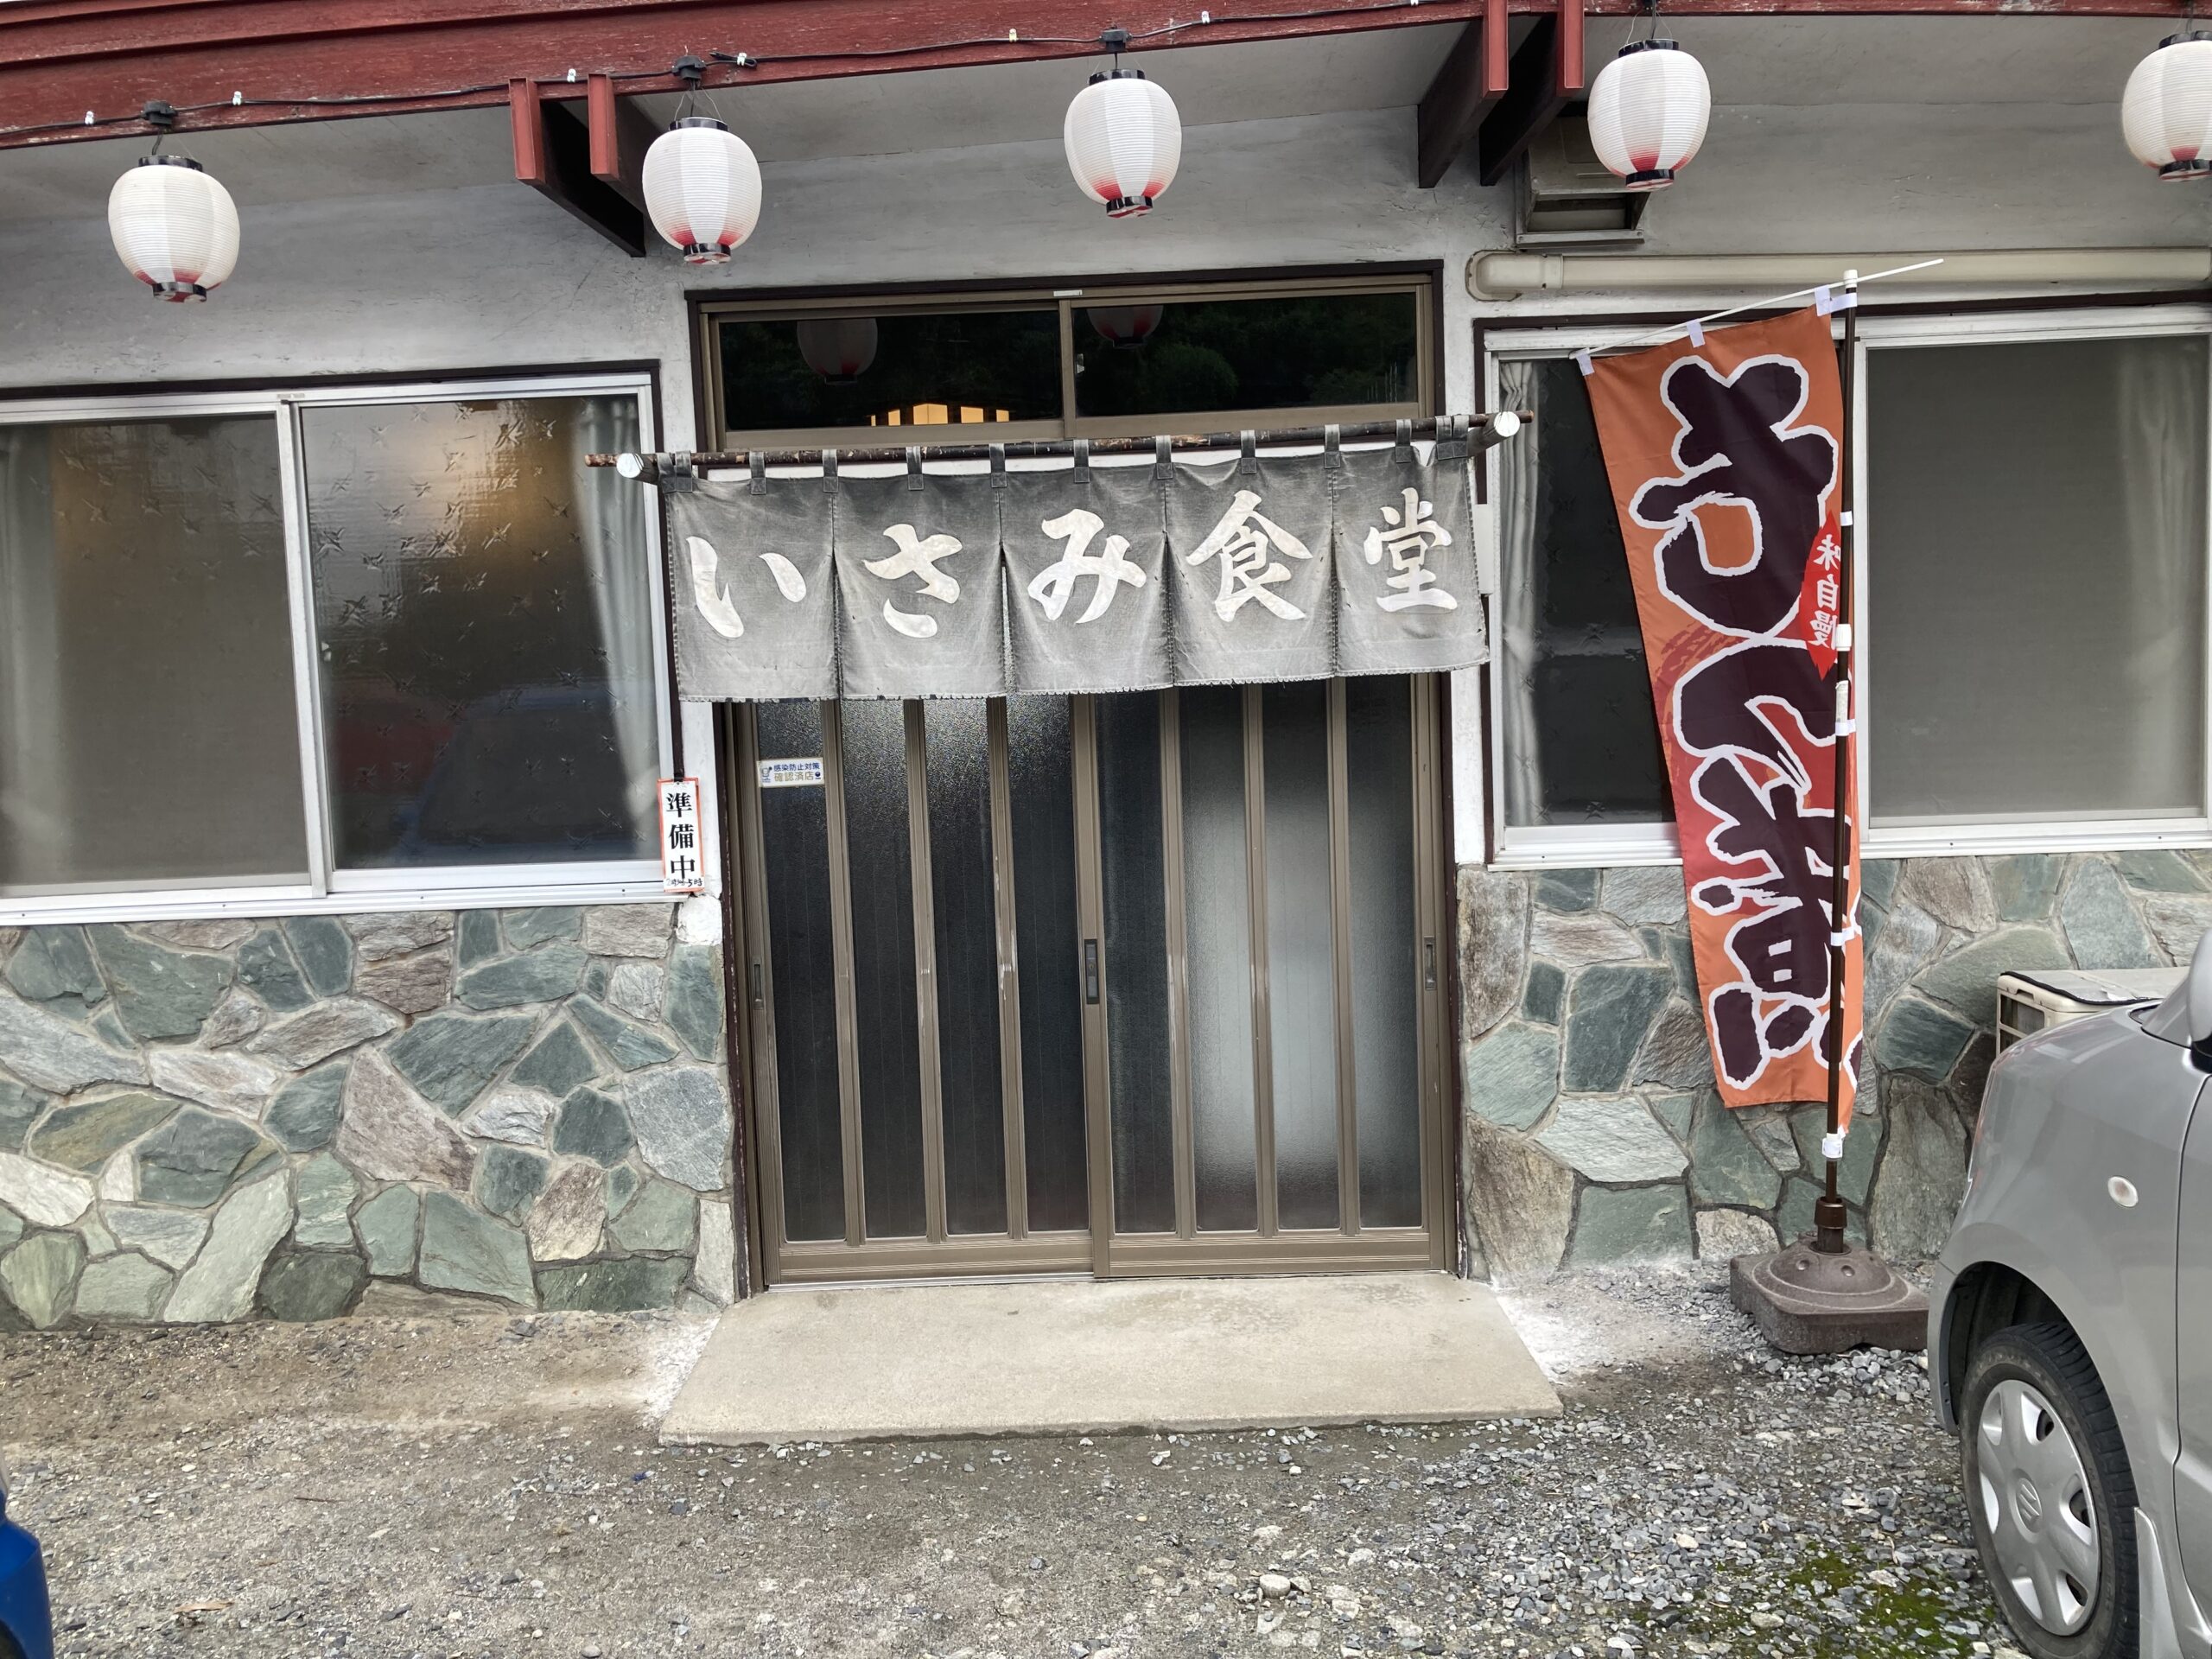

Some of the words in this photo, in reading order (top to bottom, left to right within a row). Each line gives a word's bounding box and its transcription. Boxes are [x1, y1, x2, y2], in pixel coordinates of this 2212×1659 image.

[685, 487, 1458, 639] いさみ食堂
[773, 762, 820, 772] 感染防止対策
[774, 772, 814, 782] 確認済店
[666, 791, 696, 879] 準備中
